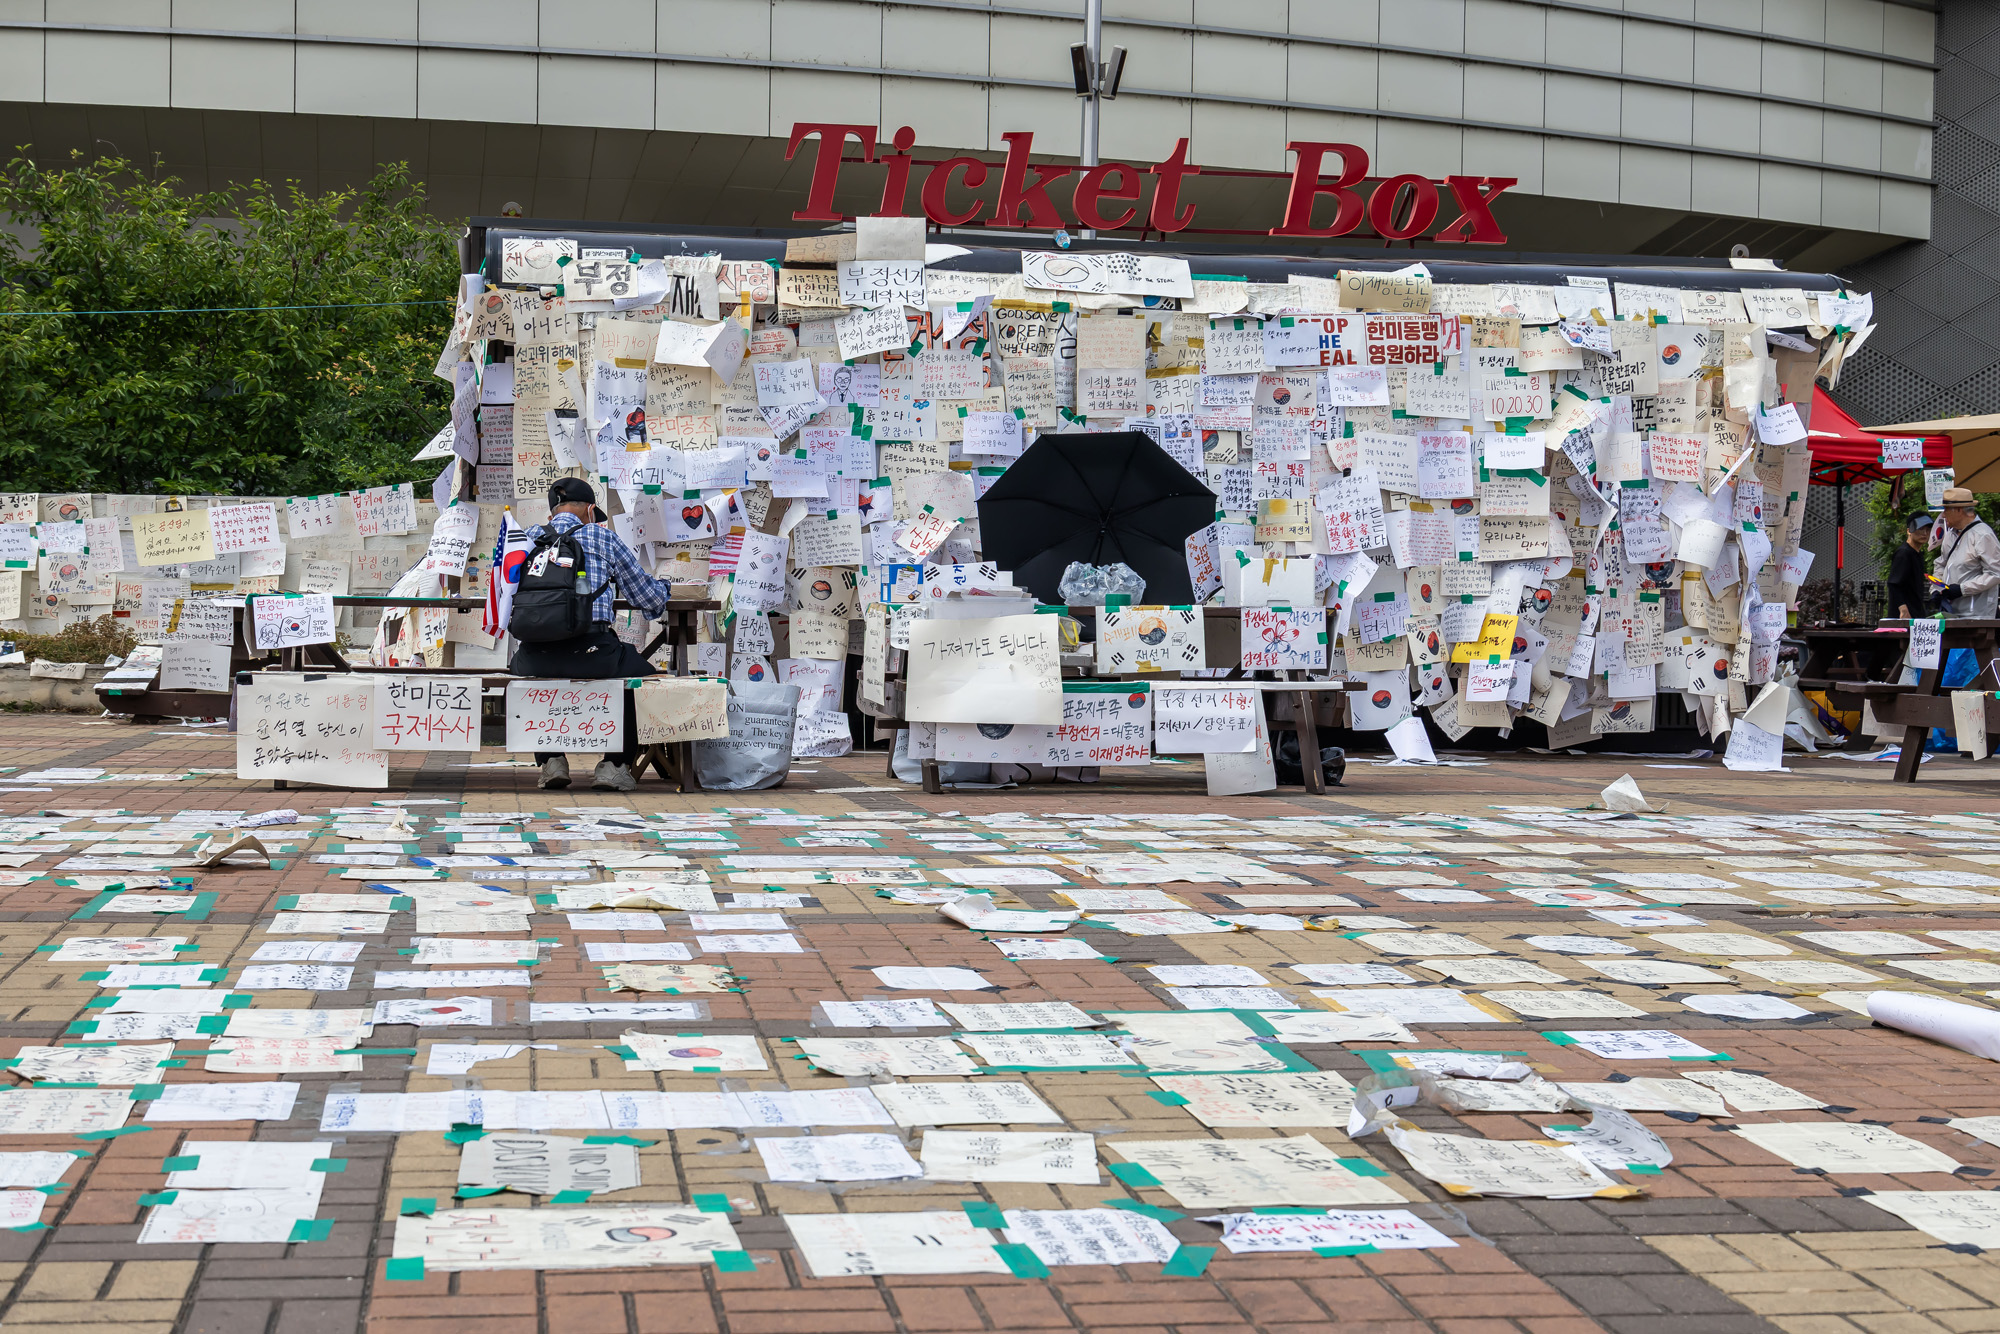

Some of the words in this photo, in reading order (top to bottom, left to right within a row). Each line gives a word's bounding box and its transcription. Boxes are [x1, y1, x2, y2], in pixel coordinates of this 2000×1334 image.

[785, 122, 1200, 231] Ticket
[1268, 141, 1518, 244] Box
[574, 262, 631, 295] 부정
[717, 263, 774, 302] 사형
[848, 267, 924, 287] 부정선거
[1403, 295, 1429, 308] 하라
[524, 314, 570, 338] 아니다
[1367, 321, 1438, 341] 한미동맹
[1319, 335, 1341, 348] HE
[516, 346, 549, 366] 선관위
[551, 344, 578, 360] 해체
[1368, 345, 1440, 364] 영원하라
[1479, 356, 1514, 367] 부정선거
[1149, 380, 1169, 399] 결국
[1486, 378, 1526, 391] 대한민국의
[1530, 376, 1540, 391] 힘
[1606, 379, 1634, 394] 했는데
[1286, 406, 1315, 416] 수개표!
[646, 416, 715, 435] 한미공조
[1714, 422, 1725, 431] 모든
[1421, 436, 1466, 449] 부정선거
[1714, 432, 1739, 446] 국민이
[1883, 441, 1919, 451] 부정선거
[1257, 462, 1278, 476] 주의
[1287, 463, 1305, 477] 빛을
[1258, 488, 1293, 499] 하소서
[3, 509, 34, 521] 재선거
[213, 518, 244, 529] 부정선거는
[215, 528, 244, 540] 부정선거
[248, 525, 270, 535] 재선거
[1258, 526, 1284, 537] 부정선거
[1289, 526, 1310, 535] 재선거
[1484, 532, 1526, 544] 우리나라
[216, 539, 245, 551] 당일투표
[1521, 540, 1548, 552] 만세
[257, 599, 294, 611] 부정선거
[304, 606, 325, 614] 수개표
[1360, 605, 1386, 621] 보수?
[1387, 600, 1407, 616] 진보?
[257, 612, 283, 621] 재선거
[1243, 611, 1278, 628] 부정선거
[1286, 610, 1323, 623] 재선거
[739, 616, 770, 636] 부정선거
[924, 638, 994, 660] 가져가도
[999, 633, 1049, 656] 됩니다.
[1136, 648, 1170, 660] 재선거
[1357, 645, 1394, 658] 재선거
[1243, 652, 1280, 667] 당일투표
[1286, 651, 1324, 665] 수개표
[789, 664, 831, 680] Freedom
[388, 681, 472, 710] 한미공조
[521, 688, 557, 705] 1989
[562, 690, 580, 705] 06
[585, 690, 612, 706] 04
[1221, 693, 1253, 711] 사형!
[256, 694, 310, 713] 영원한
[327, 694, 367, 711] 대통령
[257, 719, 307, 740] 윤석열
[317, 723, 363, 738] 당신이
[382, 714, 474, 745] 국제수사
[525, 718, 569, 734] 2026
[578, 717, 595, 734] 06
[599, 720, 617, 736] 03
[679, 721, 697, 732] 다시
[745, 717, 790, 728] guarantees
[751, 727, 768, 736] The
[769, 729, 783, 740] key
[1056, 725, 1100, 742] 부정선거
[1111, 725, 1145, 740] 대통령
[708, 740, 731, 749] giving
[743, 741, 766, 751] every
[1049, 748, 1070, 762] 책임
[1089, 744, 1149, 762] 이재명하야
